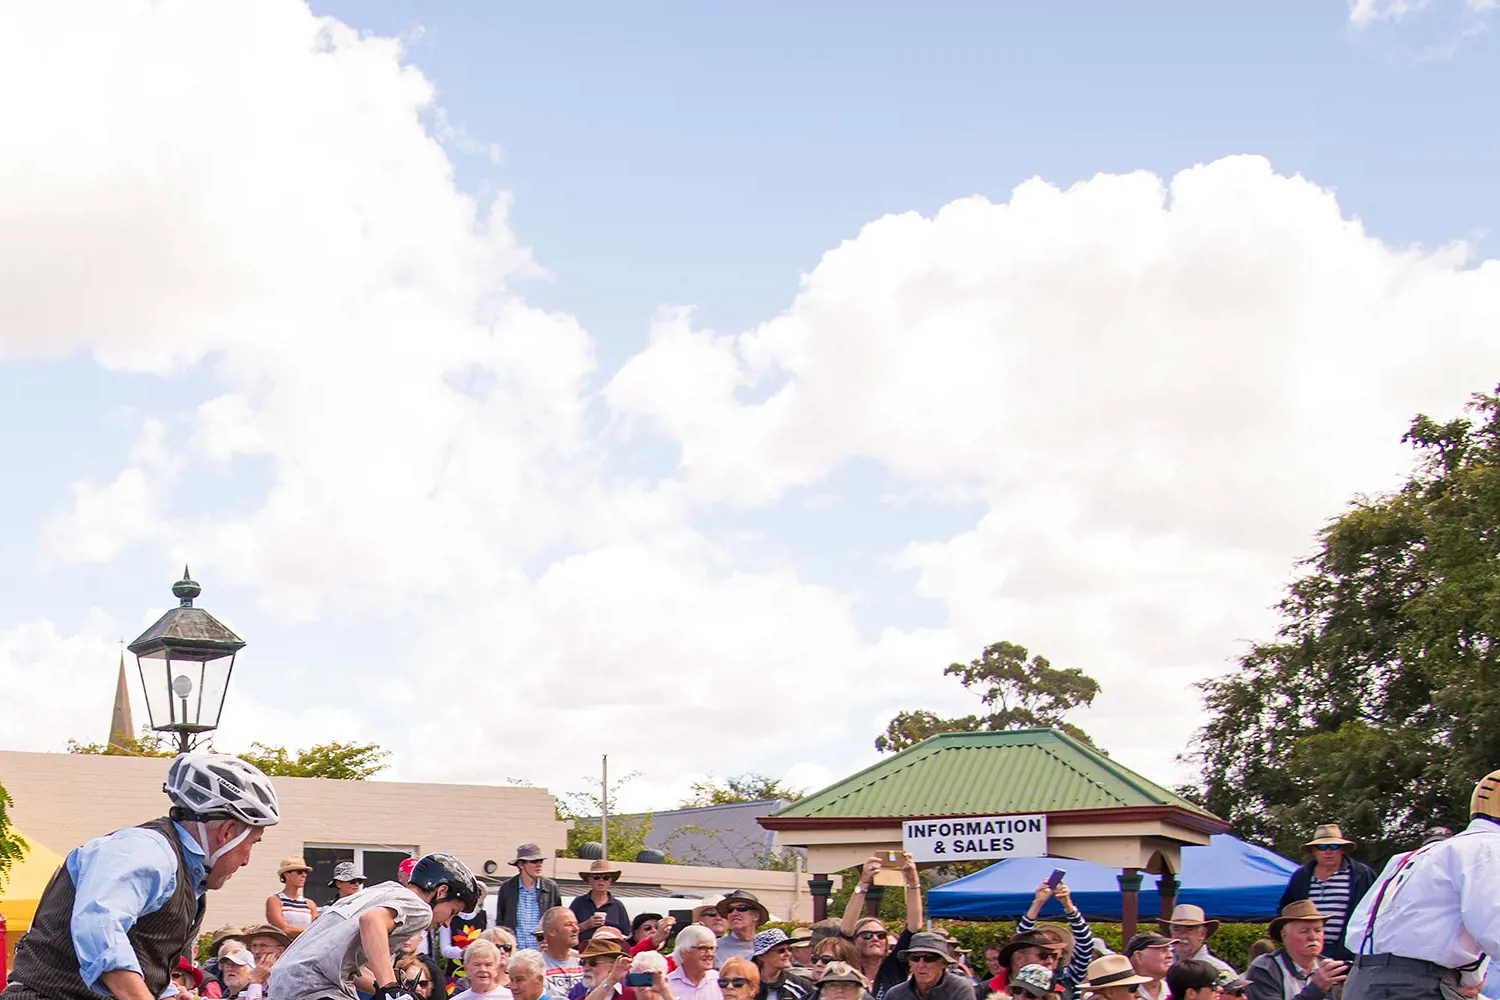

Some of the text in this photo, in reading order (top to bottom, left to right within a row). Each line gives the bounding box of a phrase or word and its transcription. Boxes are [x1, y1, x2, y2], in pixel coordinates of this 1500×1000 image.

[907, 818, 1042, 839] INFORMATION
[934, 837, 1015, 854] & SALES
